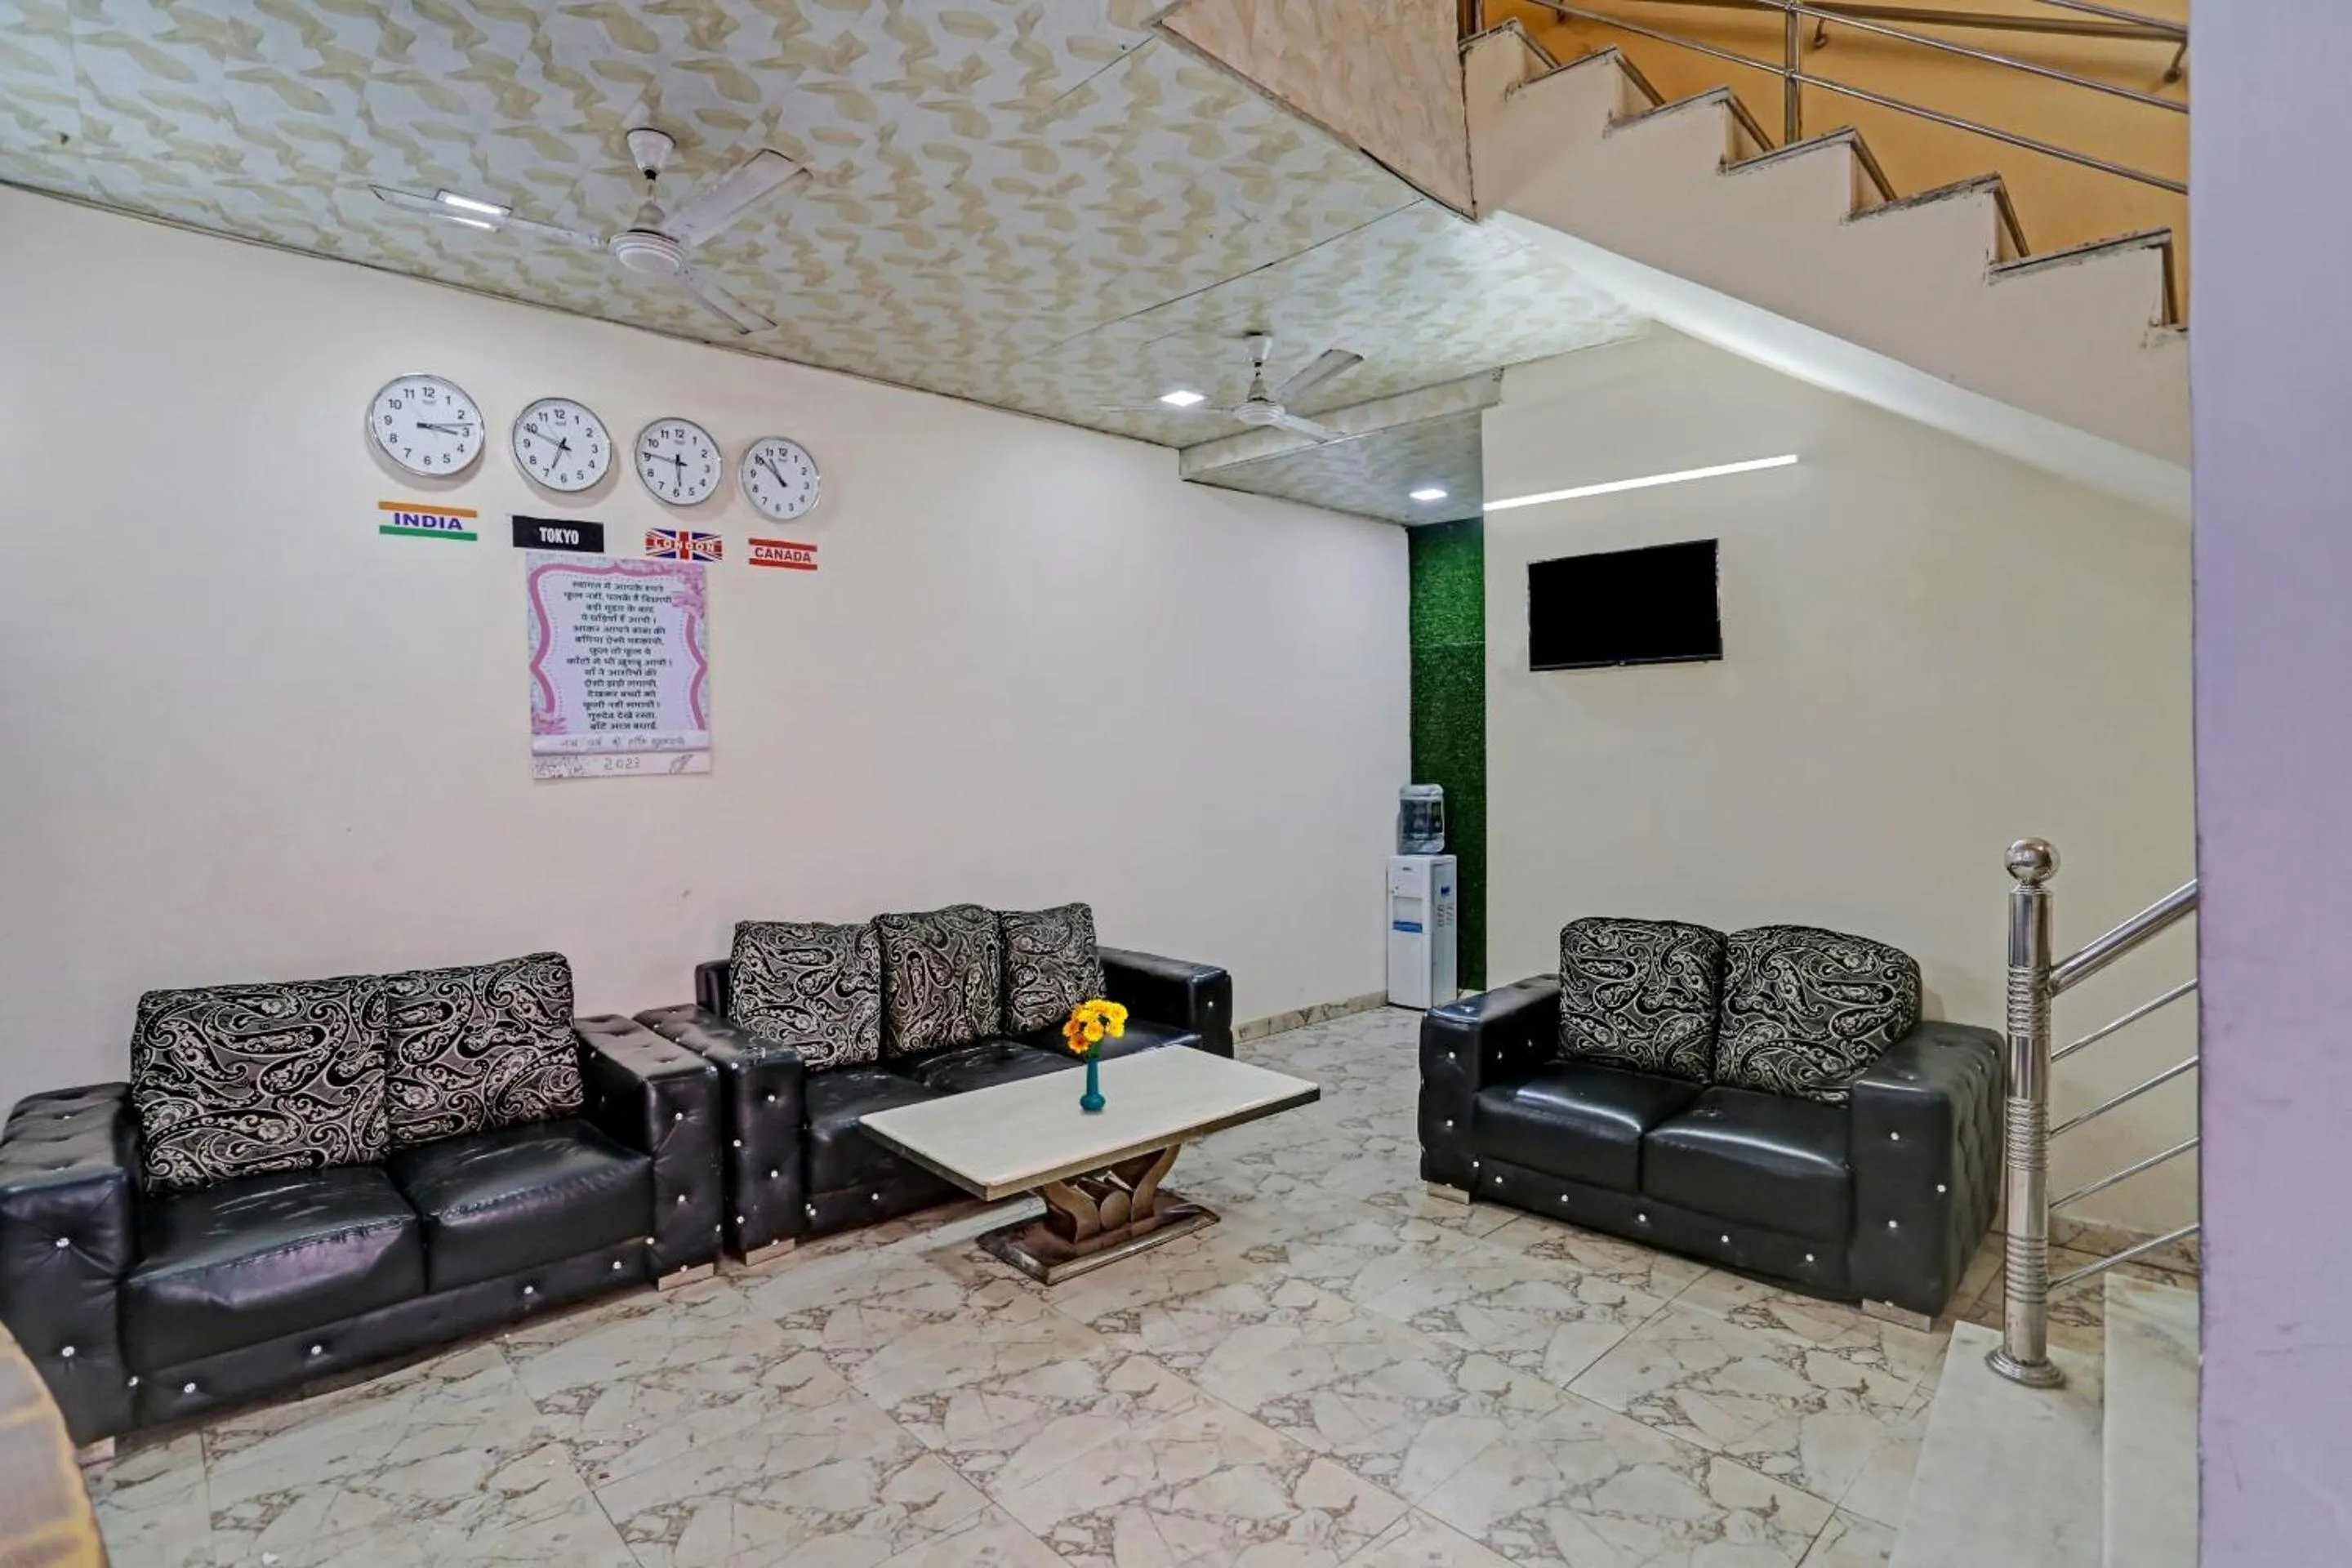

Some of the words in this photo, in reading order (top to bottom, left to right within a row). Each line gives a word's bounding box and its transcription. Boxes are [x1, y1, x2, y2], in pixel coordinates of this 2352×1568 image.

[403, 389, 415, 399] 11
[422, 387, 434, 398] 12
[389, 399, 402, 410] 10
[446, 396, 451, 405] 1
[457, 411, 465, 419] 2
[538, 412, 548, 421] 11
[554, 409, 565, 419] 12
[384, 416, 392, 425] 9
[575, 416, 579, 424] 1
[462, 428, 470, 437] 3
[586, 428, 593, 438] 2
[662, 430, 669, 439] 11
[675, 430, 684, 438] 12
[390, 434, 397, 443] 8
[457, 444, 464, 452] 4
[523, 439, 530, 448] 9
[648, 439, 658, 448] 10
[403, 448, 412, 458] 7
[591, 444, 598, 453] 3
[766, 448, 773, 457] 11
[778, 448, 787, 457] 12
[443, 454, 450, 463] 5
[702, 450, 707, 458] 2
[424, 456, 431, 465] 6
[529, 456, 537, 465] 8
[795, 455, 798, 463] 1
[588, 461, 595, 469] 4
[543, 469, 549, 477] 7
[577, 470, 584, 479] 5
[648, 469, 653, 477] 8
[751, 470, 756, 478] 9
[801, 467, 807, 475] 2
[560, 474, 567, 483] 6
[700, 479, 706, 487] 4
[658, 481, 665, 490] 7
[673, 489, 679, 497] 6
[762, 497, 767, 505] 7
[776, 503, 781, 511] 6
[789, 503, 794, 511] 5
[394, 513, 463, 530] INDIA
[539, 527, 578, 544] TOKYO
[654, 539, 714, 551] LONDON
[755, 547, 811, 562] CANADA
[604, 757, 640, 770] 2023
